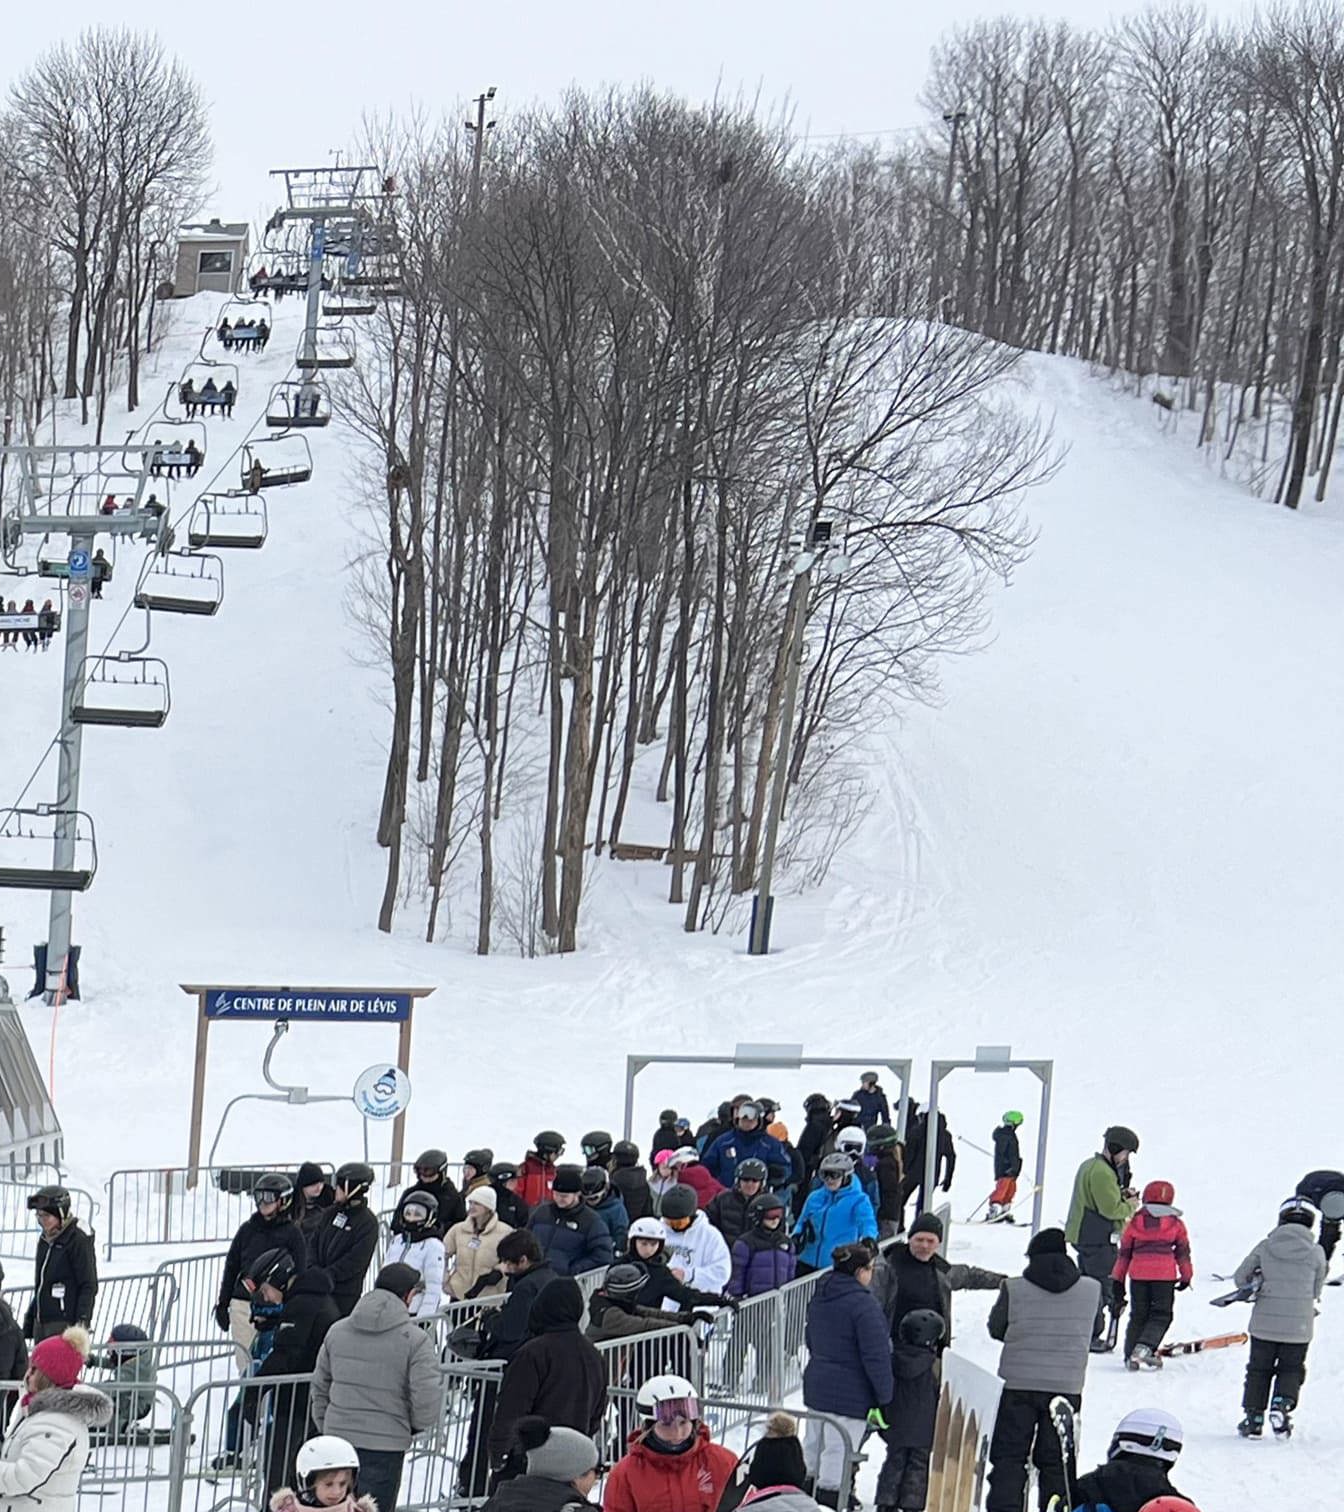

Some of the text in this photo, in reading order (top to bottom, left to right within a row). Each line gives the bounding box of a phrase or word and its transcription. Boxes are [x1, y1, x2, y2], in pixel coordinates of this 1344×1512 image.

[233, 997, 397, 1014] CENTRE DE PLEIN AIR DE LÉVIS
